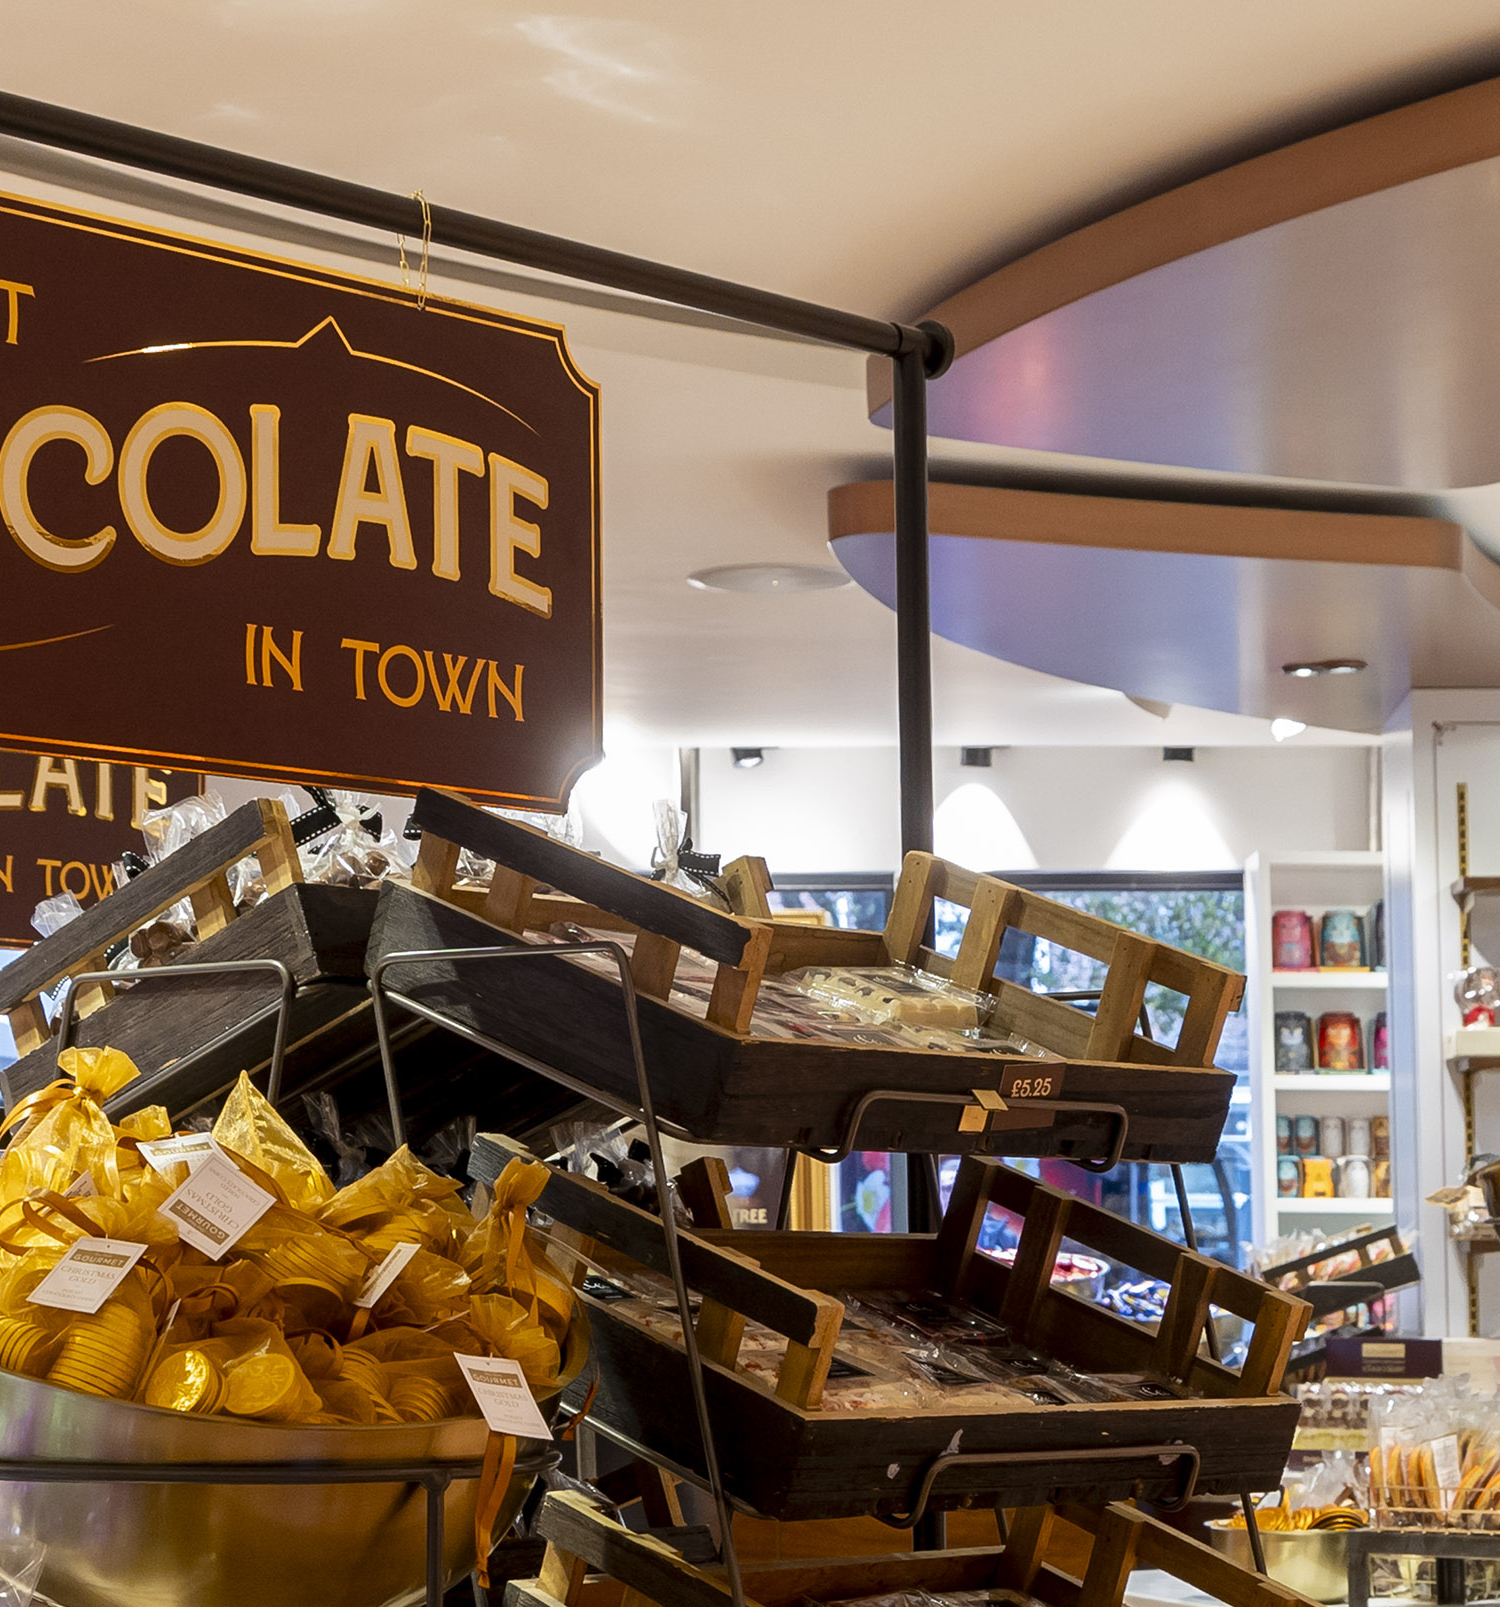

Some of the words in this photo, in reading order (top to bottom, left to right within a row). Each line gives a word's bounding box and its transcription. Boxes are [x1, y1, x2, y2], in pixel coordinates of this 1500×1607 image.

[245, 623, 304, 692] IN
[340, 637, 525, 723] TOWN
[34, 856, 119, 901] TOW
[1011, 1077, 1053, 1099] £5.25
[186, 1188, 241, 1230] CHRISTMAS
[205, 1191, 235, 1213] GOLD
[175, 1203, 226, 1241] GOURMET
[73, 1252, 125, 1268] GOURMET
[60, 1265, 116, 1281] CHRISTMAS
[471, 1372, 520, 1388] GOURMET
